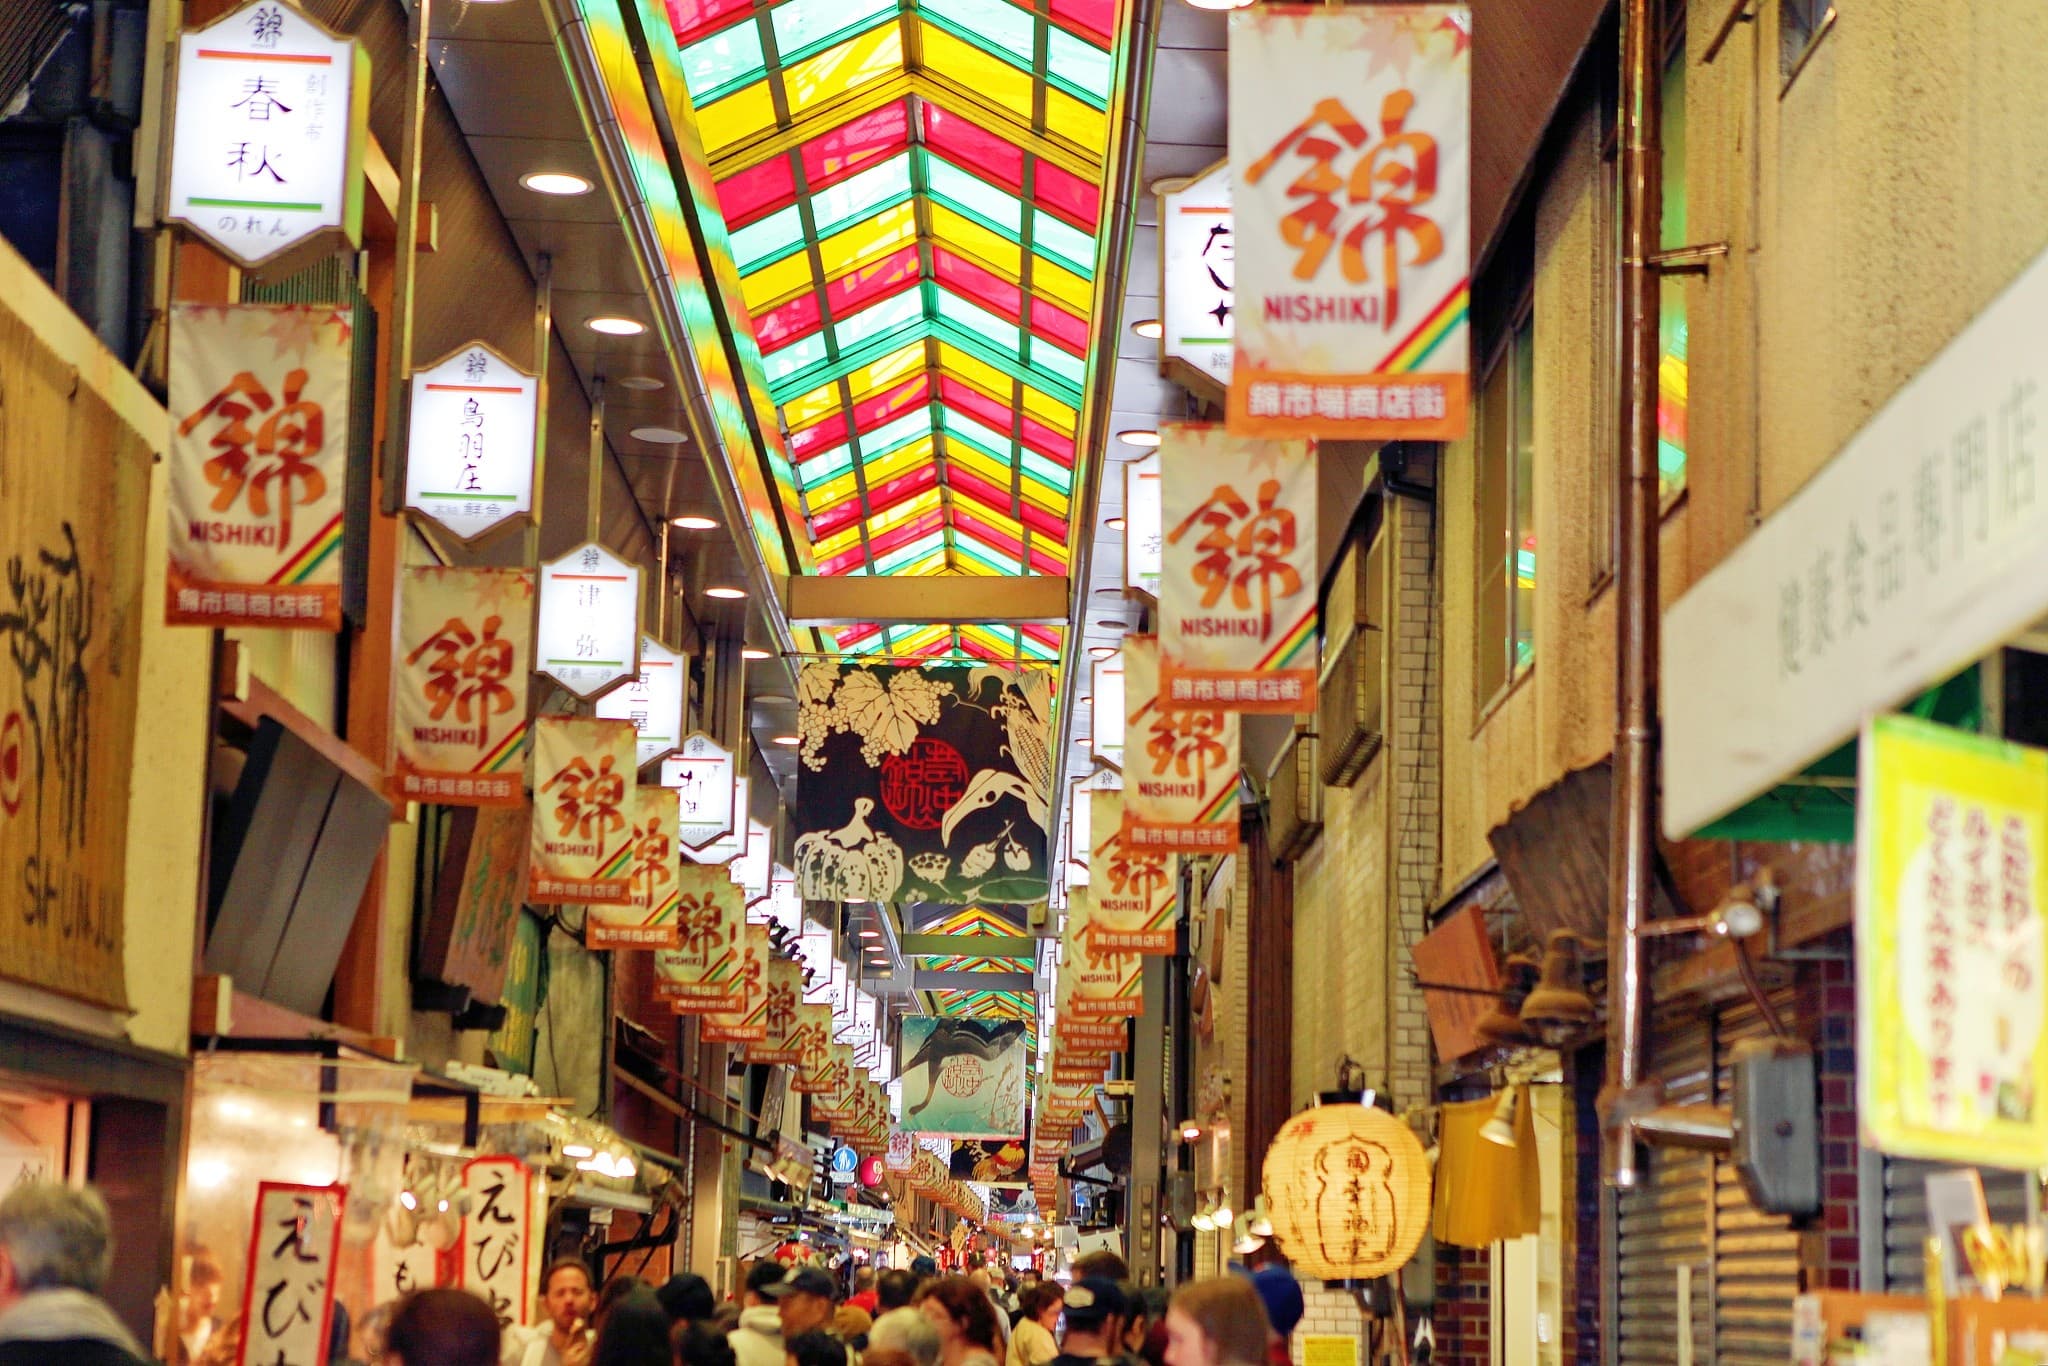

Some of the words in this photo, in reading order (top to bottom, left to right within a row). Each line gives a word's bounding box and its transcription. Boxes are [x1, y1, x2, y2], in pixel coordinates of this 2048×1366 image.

[227, 75, 292, 183] 春秋
[1244, 88, 1444, 334] 錦
[218, 216, 290, 237] のれん
[1263, 296, 1379, 324] NISHIKI
[1247, 382, 1446, 420] 錦市場商店街
[178, 367, 328, 555] 錦
[188, 520, 276, 547] NISHIKI
[1167, 479, 1303, 644] 錦
[177, 588, 324, 619] 錦市場商店街
[576, 583, 601, 657] 津弥
[1180, 618, 1258, 638] NISHIKI
[406, 614, 516, 750] 錦
[1171, 678, 1303, 702] 錦市場商店街
[413, 727, 477, 745] NISHIKI
[404, 774, 511, 797] 錦市場商店街
[1138, 782, 1196, 798] NISHIKI
[540, 755, 627, 862] 錦
[545, 842, 595, 857] NISHIKI
[1101, 899, 1144, 912] NISHIKI
[262, 1198, 326, 1366] えび
